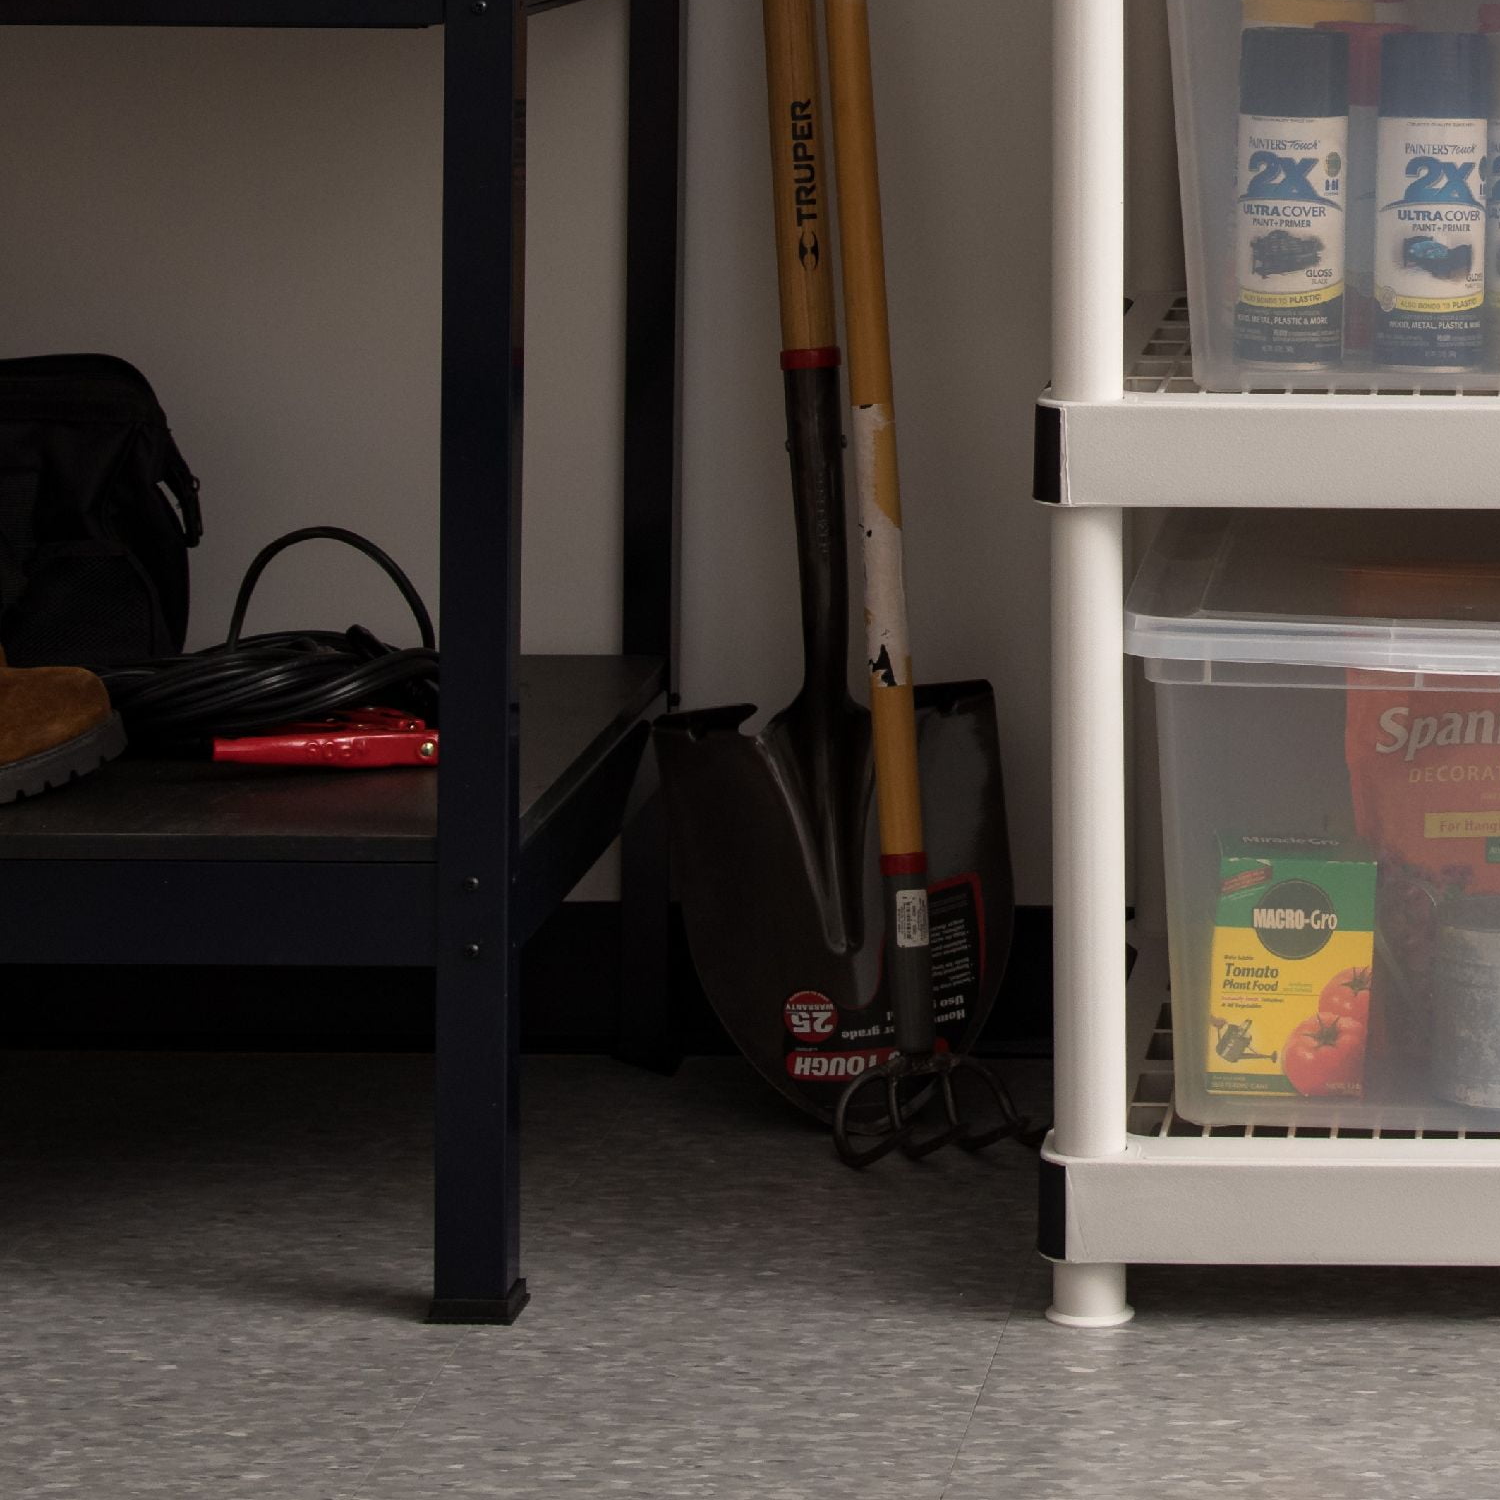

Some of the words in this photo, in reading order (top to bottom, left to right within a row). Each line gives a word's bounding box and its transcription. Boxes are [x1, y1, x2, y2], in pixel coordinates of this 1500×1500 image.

[791, 99, 818, 227] TRUPER
[1247, 150, 1320, 199] 2X
[1404, 156, 1476, 200] 2X
[1243, 204, 1280, 217] ULTRA
[1283, 206, 1326, 218] COVER
[1398, 210, 1443, 221] ULTRA
[1445, 211, 1480, 221] COVER
[1306, 268, 1333, 278] GLOSS
[1274, 316, 1302, 326] PLASTIC
[1438, 321, 1463, 330] PLASTIC
[1440, 820, 1459, 833] For
[1253, 908, 1338, 930] MACRO-Gro
[1225, 963, 1279, 979] Tomato
[1223, 979, 1251, 991] Plant
[1252, 980, 1279, 992] Food
[786, 1003, 836, 1011] WARRANTY
[790, 1011, 833, 1033] 25
[841, 1025, 881, 1041] grade
